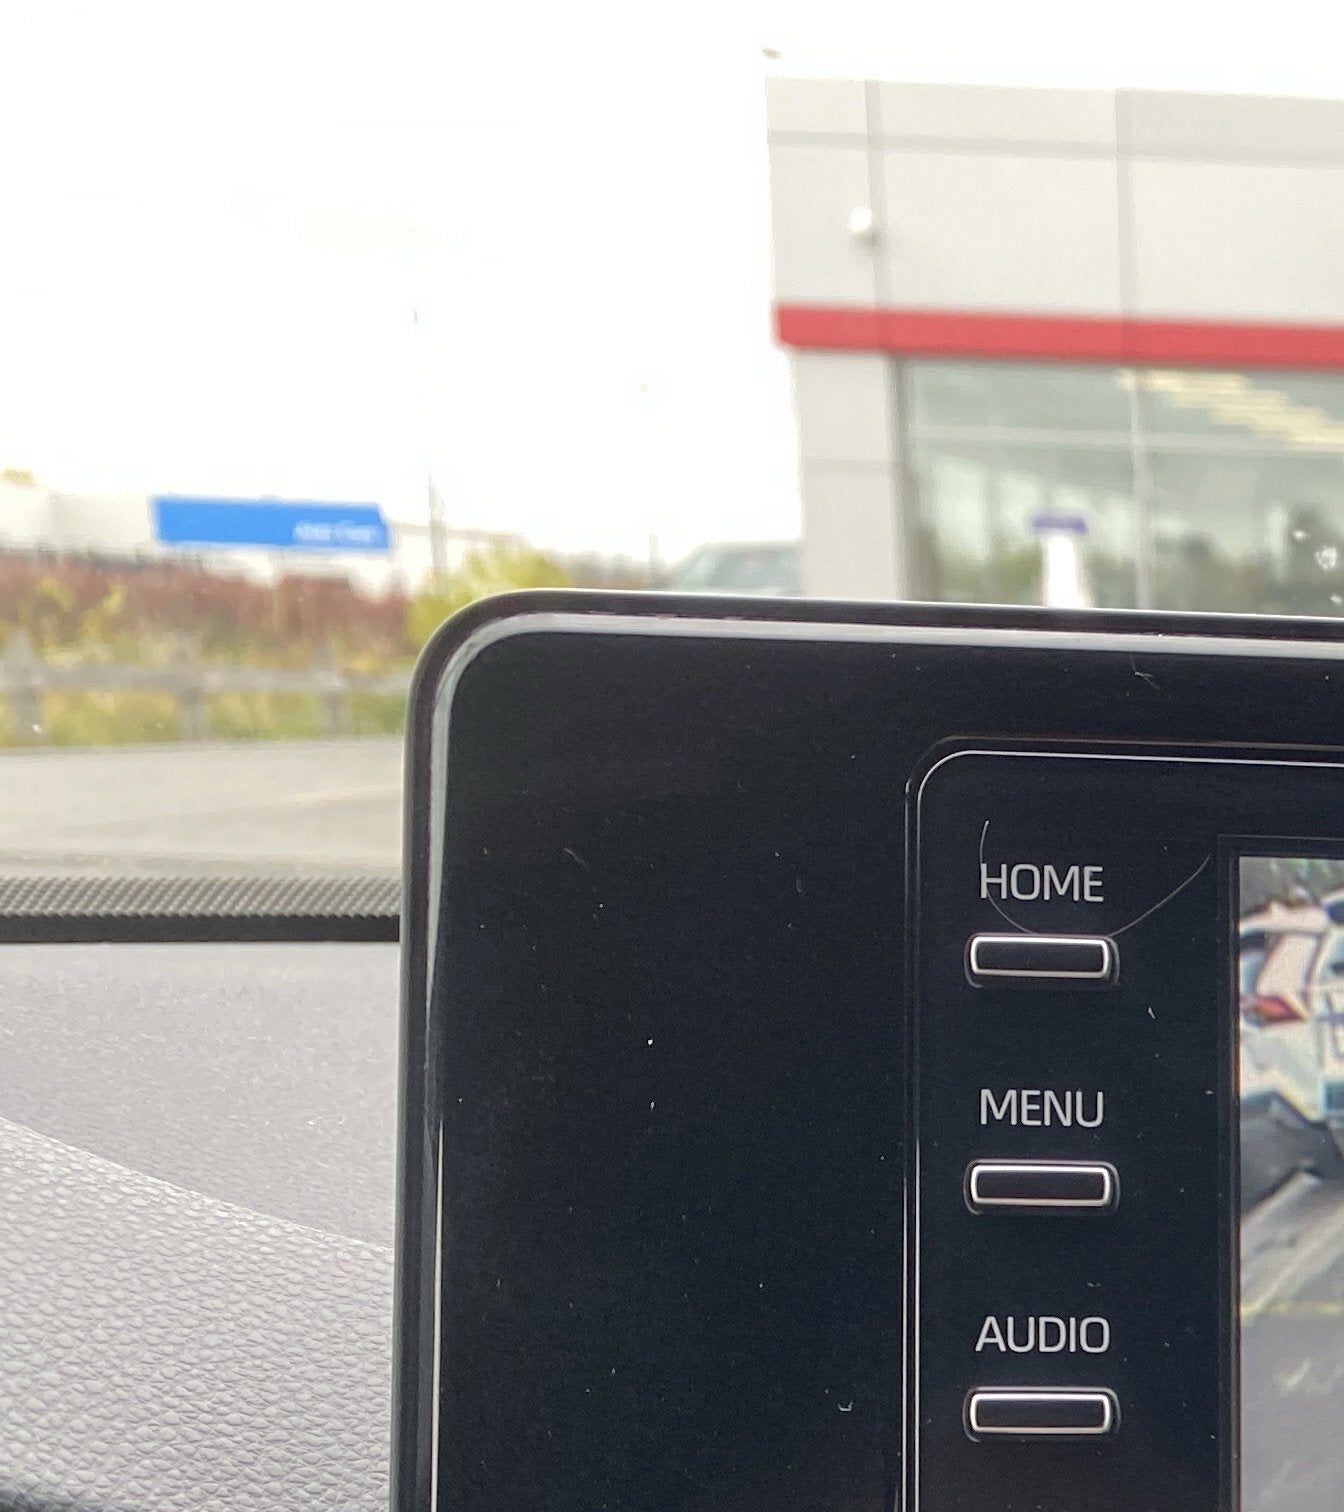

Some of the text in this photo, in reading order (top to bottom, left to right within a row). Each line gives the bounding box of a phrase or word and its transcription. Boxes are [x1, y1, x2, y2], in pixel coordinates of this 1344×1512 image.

[979, 862, 1104, 902] HOME
[979, 1087, 1104, 1128] MENU
[975, 1315, 1111, 1354] AUDIO
